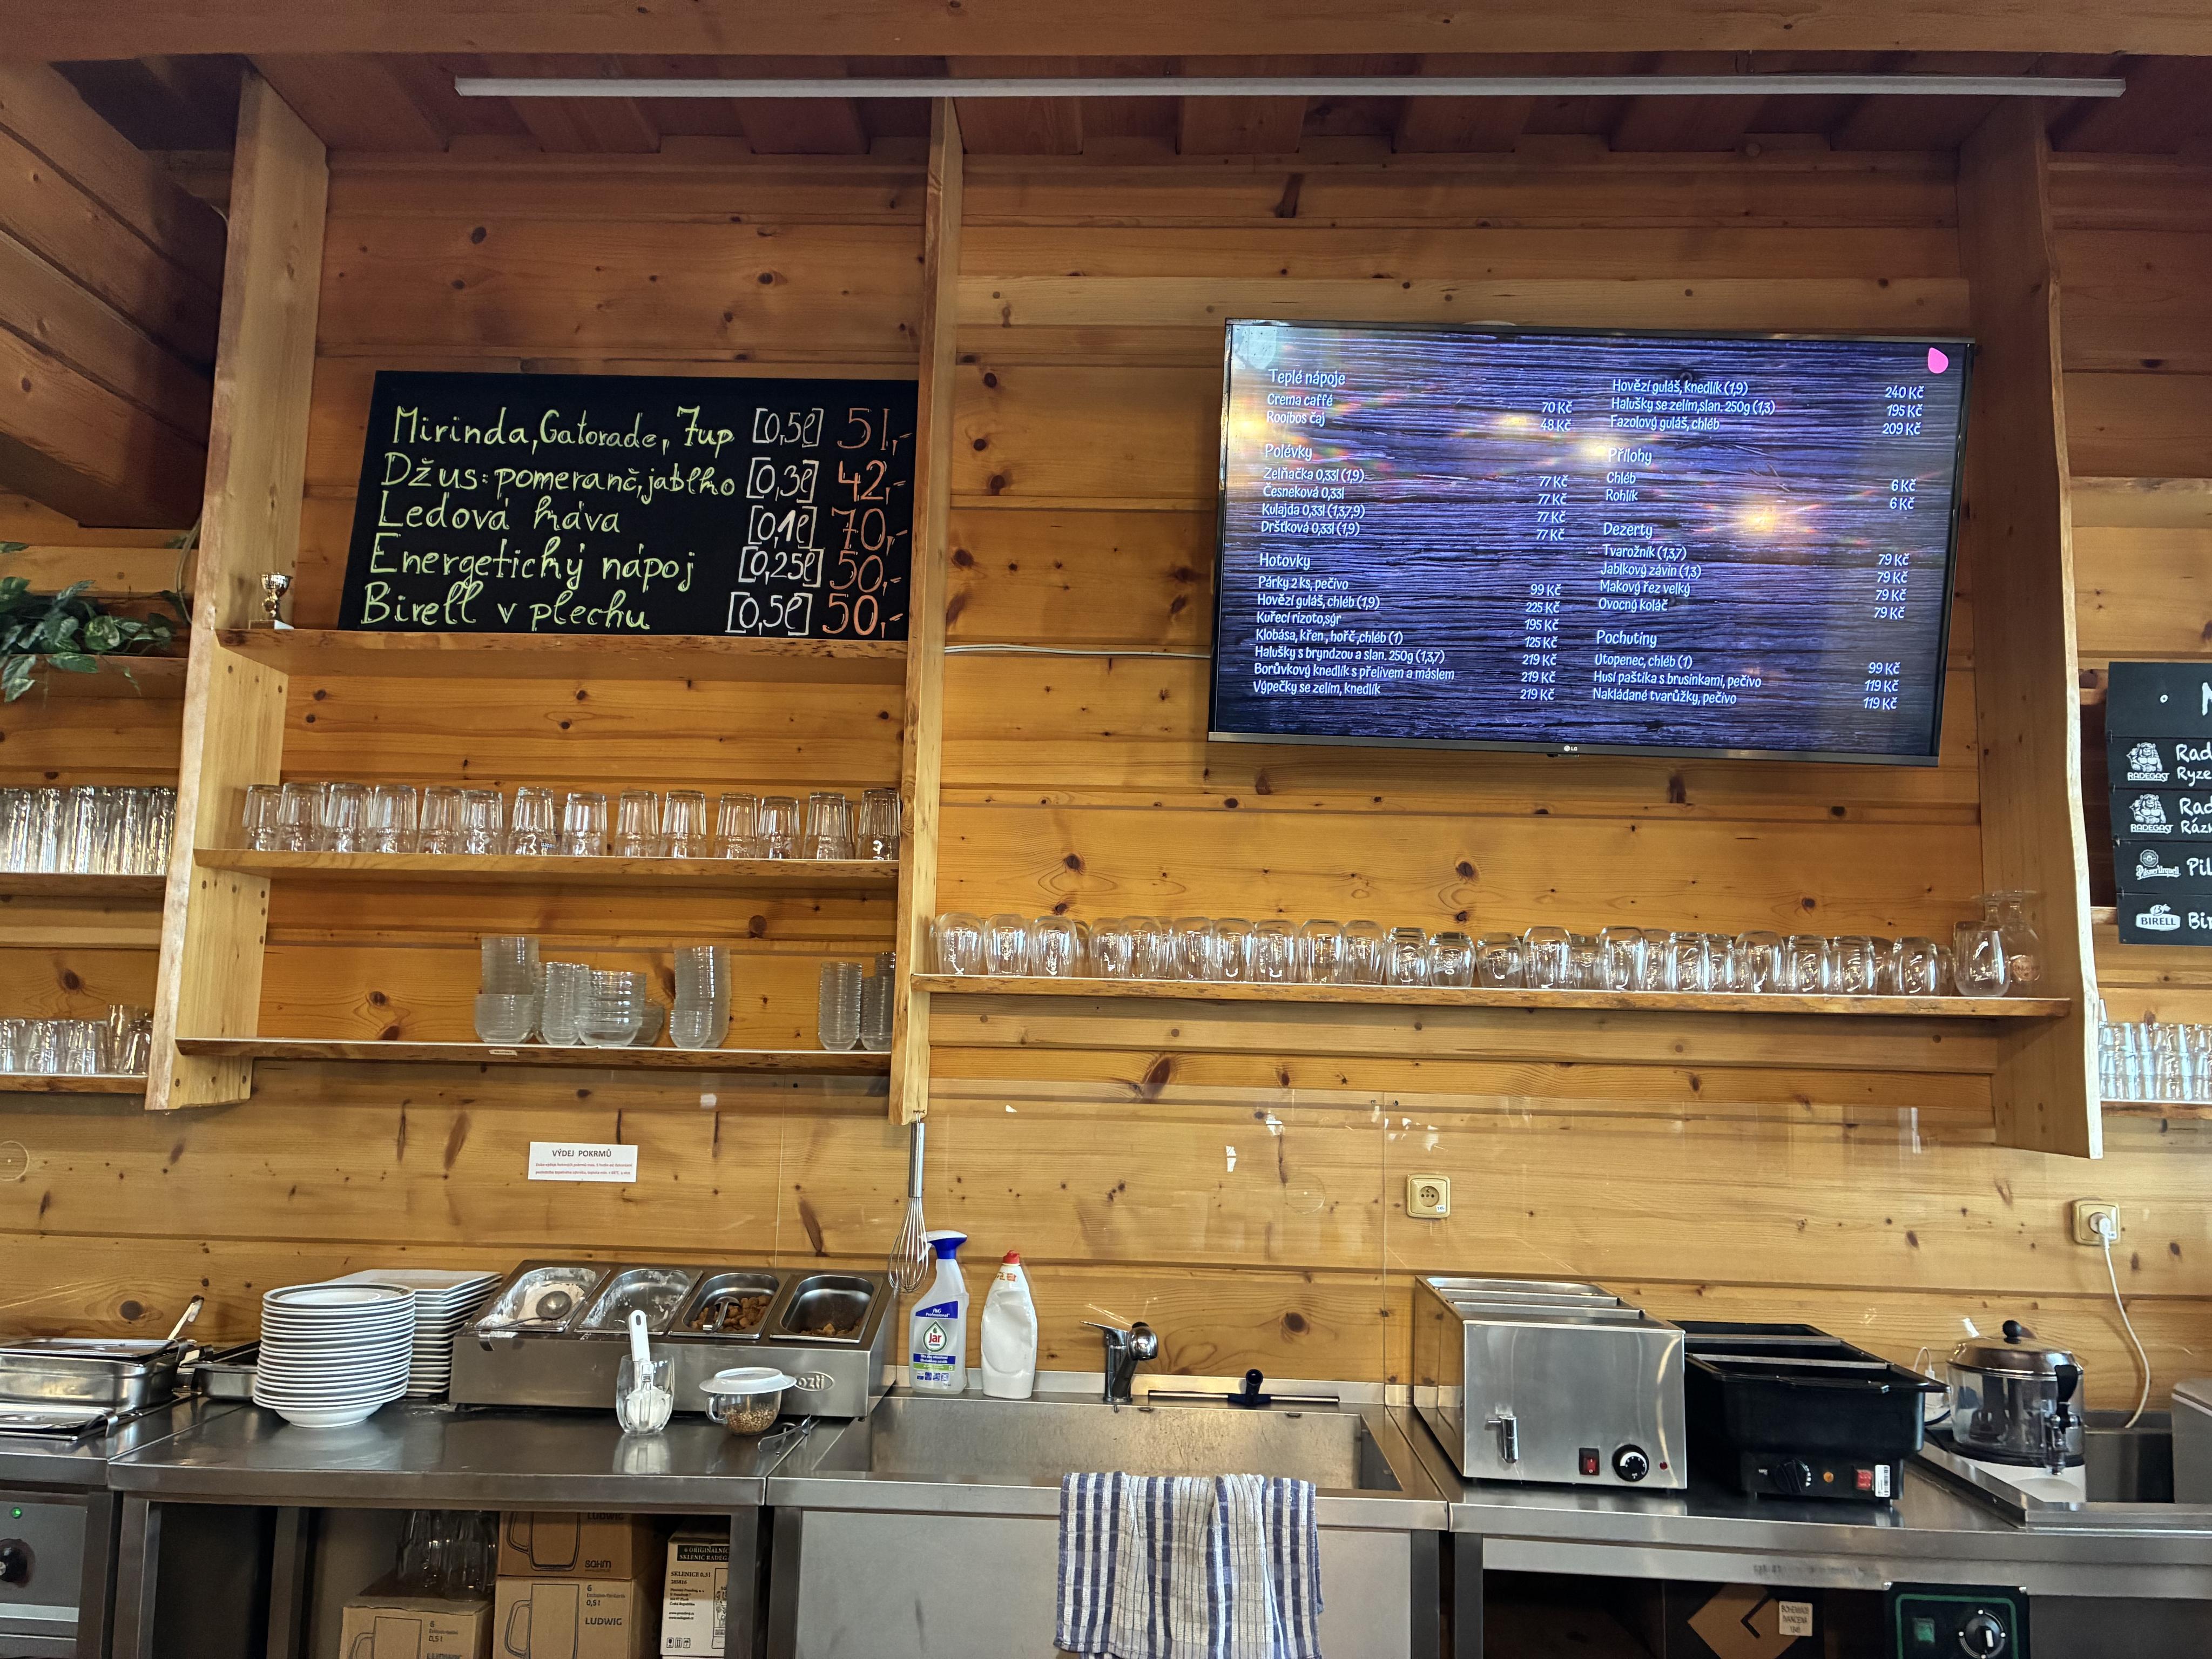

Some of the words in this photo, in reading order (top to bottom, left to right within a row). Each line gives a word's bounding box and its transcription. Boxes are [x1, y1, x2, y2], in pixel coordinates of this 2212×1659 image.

[1268, 368, 1302, 387] Teplé
[1305, 371, 1346, 387] nápoje
[1613, 379, 1650, 392] Hovězí
[1652, 381, 1683, 395] guláš,
[1685, 381, 1722, 394] knedlík
[1724, 381, 1749, 397] (1,9)
[1267, 393, 1301, 406] Crema
[1304, 394, 1333, 406] caffé
[1542, 402, 1555, 413] 70
[1558, 401, 1573, 414] Kč
[1611, 397, 1653, 413] Halušky
[1656, 401, 1668, 410] se
[1725, 401, 1750, 415] 250g
[1752, 400, 1775, 415] (1,3)
[1267, 411, 1307, 423] Rooibos
[1310, 412, 1325, 427] čaj
[1541, 418, 1554, 430] 48
[1557, 419, 1572, 431] Kč
[1610, 415, 1657, 430] Fazolový
[1660, 416, 1689, 431] guláš,
[1692, 417, 1720, 430] chléb
[677, 405, 734, 459] 7up
[1265, 443, 1312, 461] Polévky
[1608, 448, 1652, 466] Přílohy
[838, 460, 907, 505] 42,-
[1263, 468, 1313, 481] Zelňačka
[1316, 469, 1339, 483] 0,33l
[1341, 469, 1365, 483] (1,9)
[1540, 476, 1552, 487] 77
[1554, 475, 1568, 488] Kč
[1607, 471, 1636, 484] Chléb
[1263, 483, 1319, 498] Česneková
[1321, 487, 1345, 501] 0,33l
[1892, 479, 1899, 491] 6
[1901, 478, 1917, 492] Kč
[1606, 489, 1638, 502] Rohlík
[1262, 503, 1299, 518] Kulajda
[1303, 504, 1325, 518] 0,33l
[377, 490, 510, 531] Ledová
[533, 495, 621, 533] káva
[831, 507, 909, 555] 70,-
[1262, 521, 1309, 534] Dršťková
[1311, 522, 1334, 536] 0,33l
[1337, 522, 1360, 537] (1,9)
[1603, 522, 1653, 539] Dezerty
[1602, 544, 1655, 558] Tvarožník
[370, 532, 585, 590] Energetický
[602, 543, 694, 594] nápoj
[829, 551, 902, 596] 50,-
[1259, 553, 1311, 571] Hotovky
[1879, 553, 1892, 565] 79
[1894, 553, 1910, 566] Kč
[1601, 563, 1647, 578] Jablkový
[1649, 564, 1677, 576] závin
[1679, 565, 1702, 579] (1,3)
[1258, 576, 1289, 591] Párky
[1291, 578, 1297, 588] 2
[1299, 577, 1313, 591] ks,
[1315, 577, 1349, 591] pečivo
[1530, 584, 1545, 595] 99
[1547, 584, 1562, 596] Kč
[1600, 579, 1641, 595] Makový
[1643, 581, 1661, 594] řez
[1663, 582, 1690, 597] velký
[361, 581, 484, 625] Birell
[497, 603, 518, 623] v
[529, 589, 650, 632] plechu
[822, 592, 903, 638] 50,-
[1258, 594, 1295, 606] Hovězí
[1296, 595, 1325, 610] guláš,
[1327, 595, 1354, 607] chléb
[1357, 595, 1380, 610] (1,9)
[1599, 598, 1637, 612] Ovocný
[1640, 598, 1669, 611] koláč
[1257, 611, 1290, 624] Kuřecí
[1256, 628, 1298, 643] Klobása,
[1300, 629, 1323, 642] křen
[1388, 630, 1404, 645] (1)
[1596, 630, 1657, 648] Pochutiny
[1255, 645, 1296, 661] Halušky
[1298, 650, 1303, 659] s
[1306, 647, 1353, 662] bryndzou
[1355, 651, 1361, 660] a
[1364, 649, 1387, 662] slan.
[1389, 650, 1413, 664] 250g
[1522, 653, 1540, 665] 219
[1543, 653, 1557, 666] Kč
[1595, 653, 1646, 669] Utopenec,
[1648, 655, 1675, 667] chléb
[1678, 655, 1692, 669] (1)
[1255, 662, 1311, 678] Borůvkový
[1313, 664, 1350, 677] knedlík
[1351, 667, 1357, 677] s
[1360, 665, 1404, 680] přelivem
[1406, 670, 1412, 679] a
[1415, 667, 1454, 680] máslem
[1253, 680, 1297, 695] Výpečky
[1299, 683, 1310, 693] se
[1313, 682, 1343, 696] zelím,
[1345, 682, 1381, 695] knedlík
[1594, 671, 1615, 683] Husí
[1618, 672, 1657, 685] paštika
[1660, 676, 1664, 684] s
[1667, 673, 1726, 688] brusinkami,
[1728, 675, 1762, 689] pečivo
[1594, 688, 1647, 702] Nakládané
[1650, 689, 1701, 705] tvarůžky,
[1703, 692, 1737, 705] pečivo
[2127, 772, 2170, 782] RADEGAST
[2176, 766, 2212, 787] Ryze
[2130, 824, 2174, 834] RADEGAST
[2136, 865, 2157, 880] Pilsner
[2157, 865, 2181, 878] Urquell
[2141, 918, 2176, 926] BIRELL
[552, 1149, 575, 1157] VÝDEJ
[578, 1149, 611, 1157] POKRMŮ
[929, 1333, 942, 1343] Jar
[585, 1617, 622, 1626] LUDWIG
